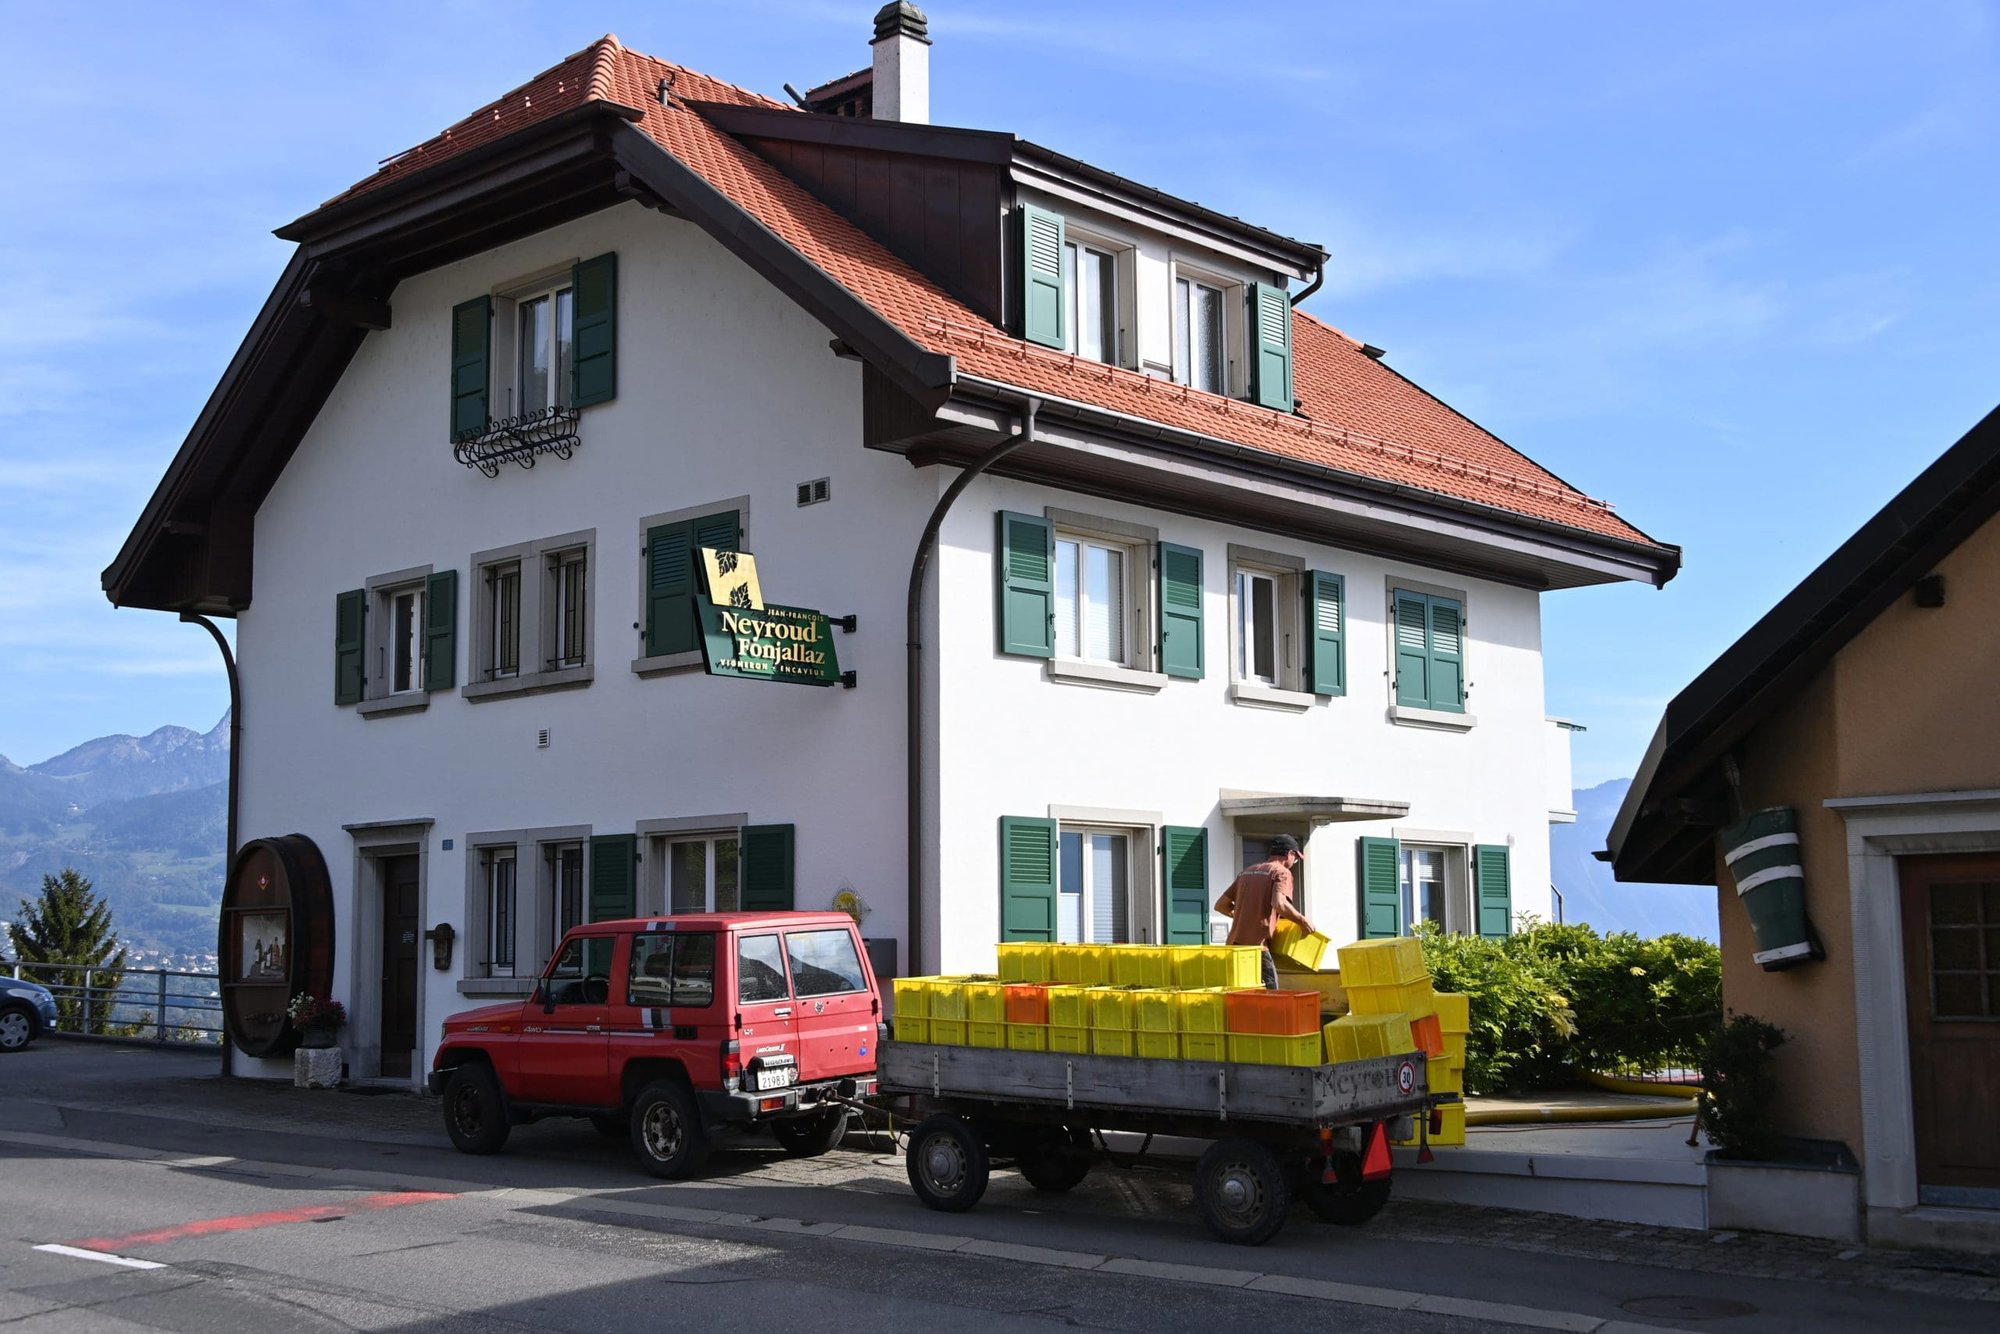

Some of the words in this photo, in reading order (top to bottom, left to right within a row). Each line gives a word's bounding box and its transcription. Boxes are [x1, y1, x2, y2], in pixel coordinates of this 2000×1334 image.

[721, 611, 823, 643] Neyroud-
[738, 638, 825, 665] Fonjallaz
[720, 659, 768, 671] VIGNERON
[780, 665, 825, 676] ENCAVEUR
[1402, 1071, 1411, 1084] 30
